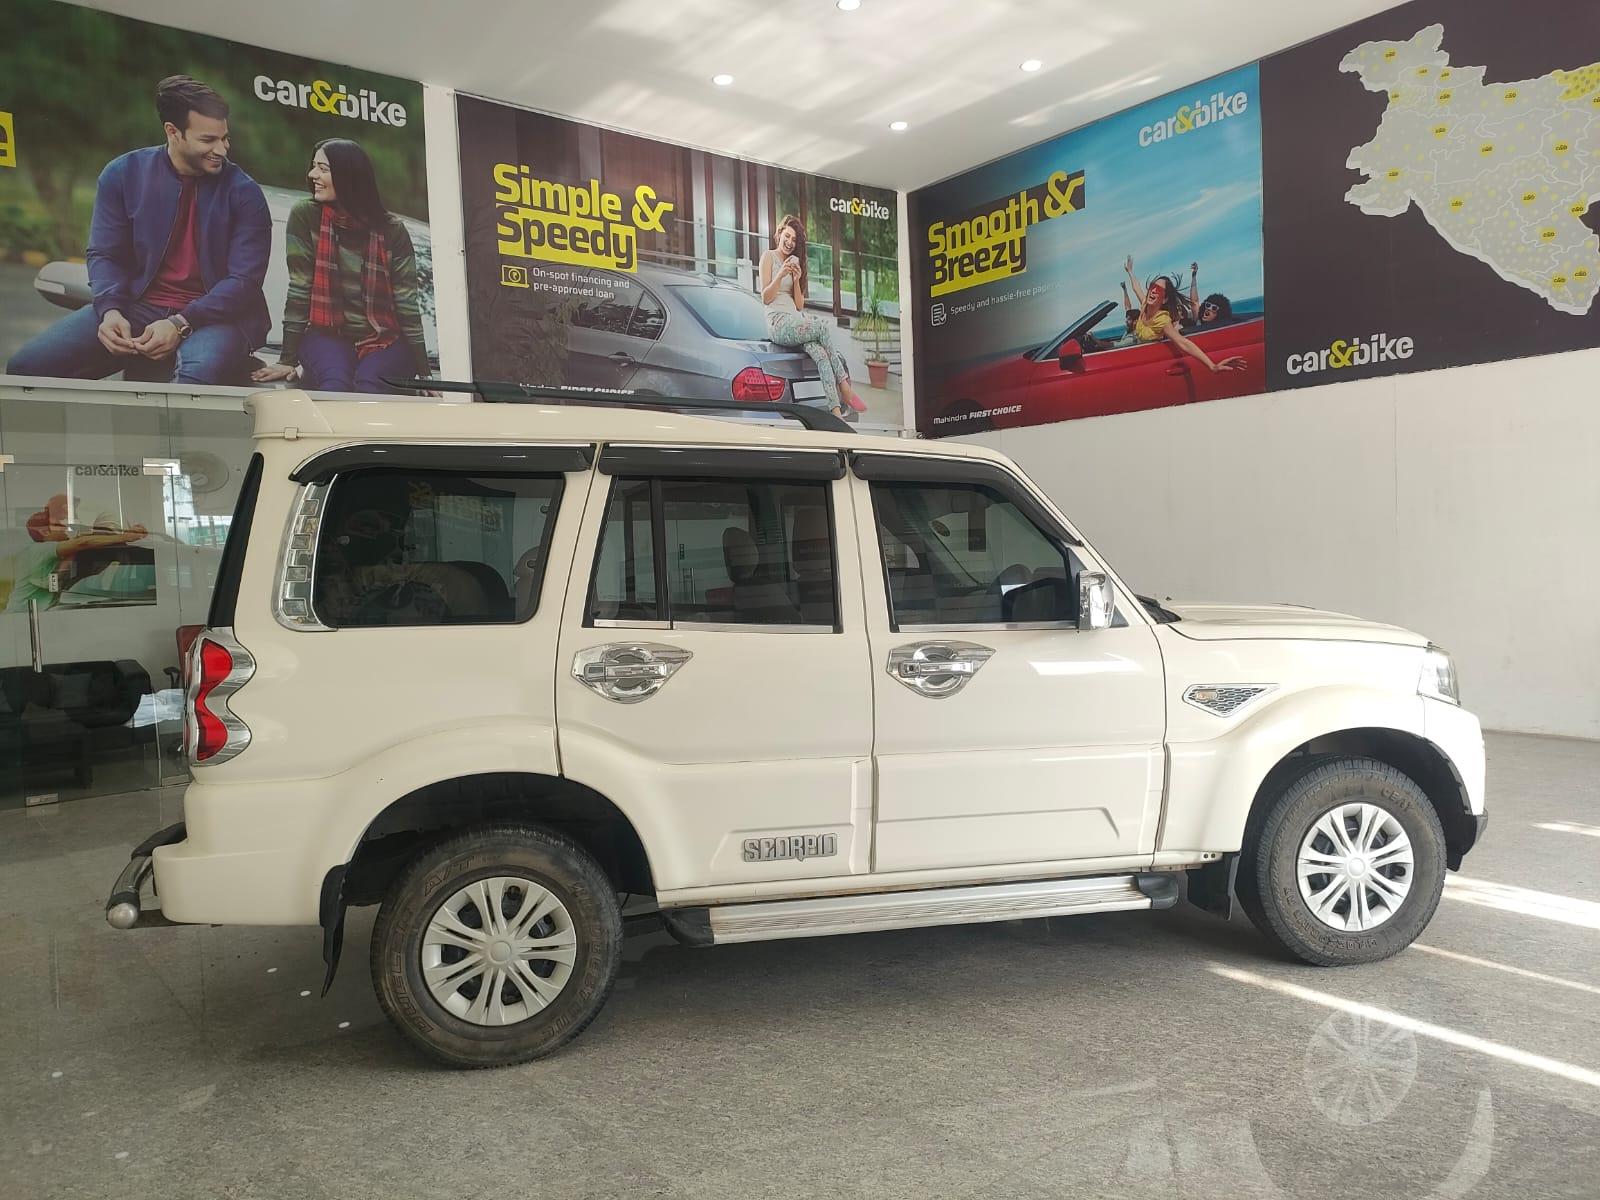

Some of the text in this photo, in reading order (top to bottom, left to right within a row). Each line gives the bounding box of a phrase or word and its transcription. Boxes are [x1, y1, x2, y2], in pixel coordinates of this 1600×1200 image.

[254, 75, 407, 128] car&bike
[1138, 90, 1247, 148] car&bike
[493, 162, 674, 233] Simple &
[829, 196, 890, 221] car&bike
[928, 170, 1085, 256] Smooth &
[497, 205, 634, 269] Speedy
[930, 233, 1027, 286] Breezy
[532, 267, 630, 289] On-spot financing and
[533, 282, 614, 299] pre-approved loan
[950, 302, 976, 316] Speedy
[976, 298, 990, 309] and
[991, 287, 1031, 304] hassle-free
[1286, 333, 1414, 375] car&bike
[933, 404, 1022, 425] Mahindra FIRST CHOICE
[75, 464, 139, 477] car&bike
[743, 833, 838, 862] SCORPIO
